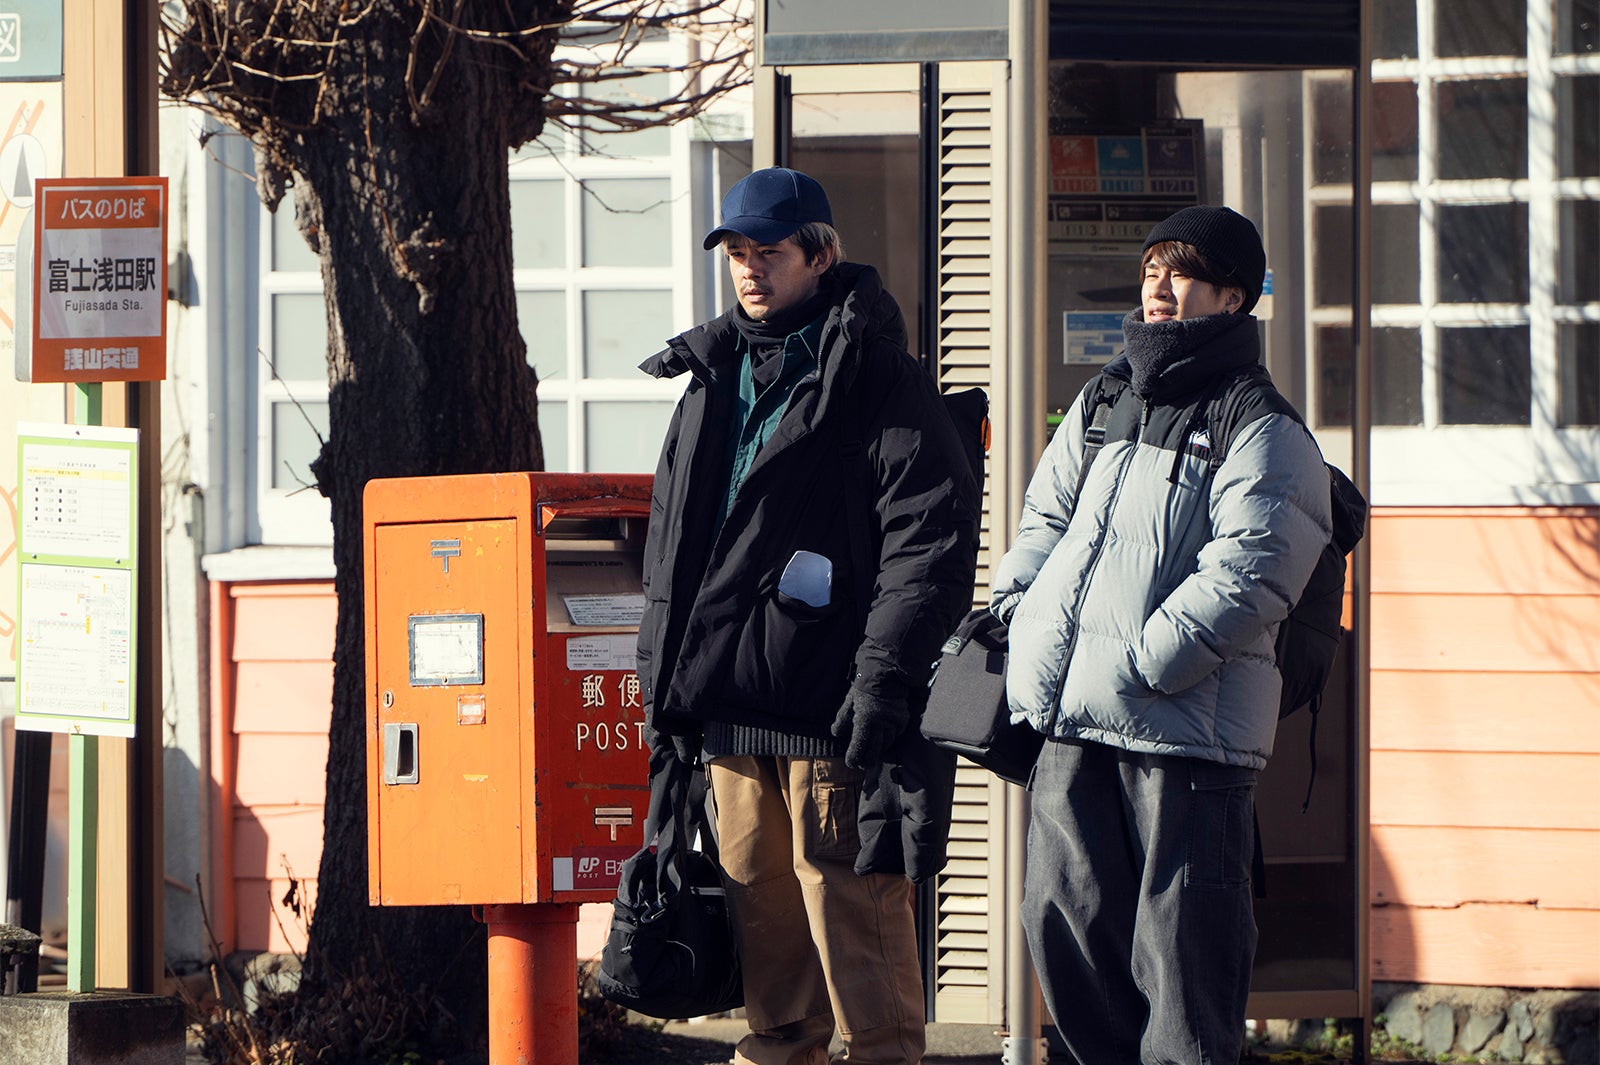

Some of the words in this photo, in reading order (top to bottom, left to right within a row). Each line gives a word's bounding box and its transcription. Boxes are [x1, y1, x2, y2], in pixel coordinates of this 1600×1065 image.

[61, 197, 146, 220] バスのりば
[48, 257, 156, 293] 富士浅田駅
[65, 300, 118, 314] Fujiasada
[122, 299, 143, 311] Sta.
[582, 674, 640, 708] 郵便
[577, 722, 646, 751] POST
